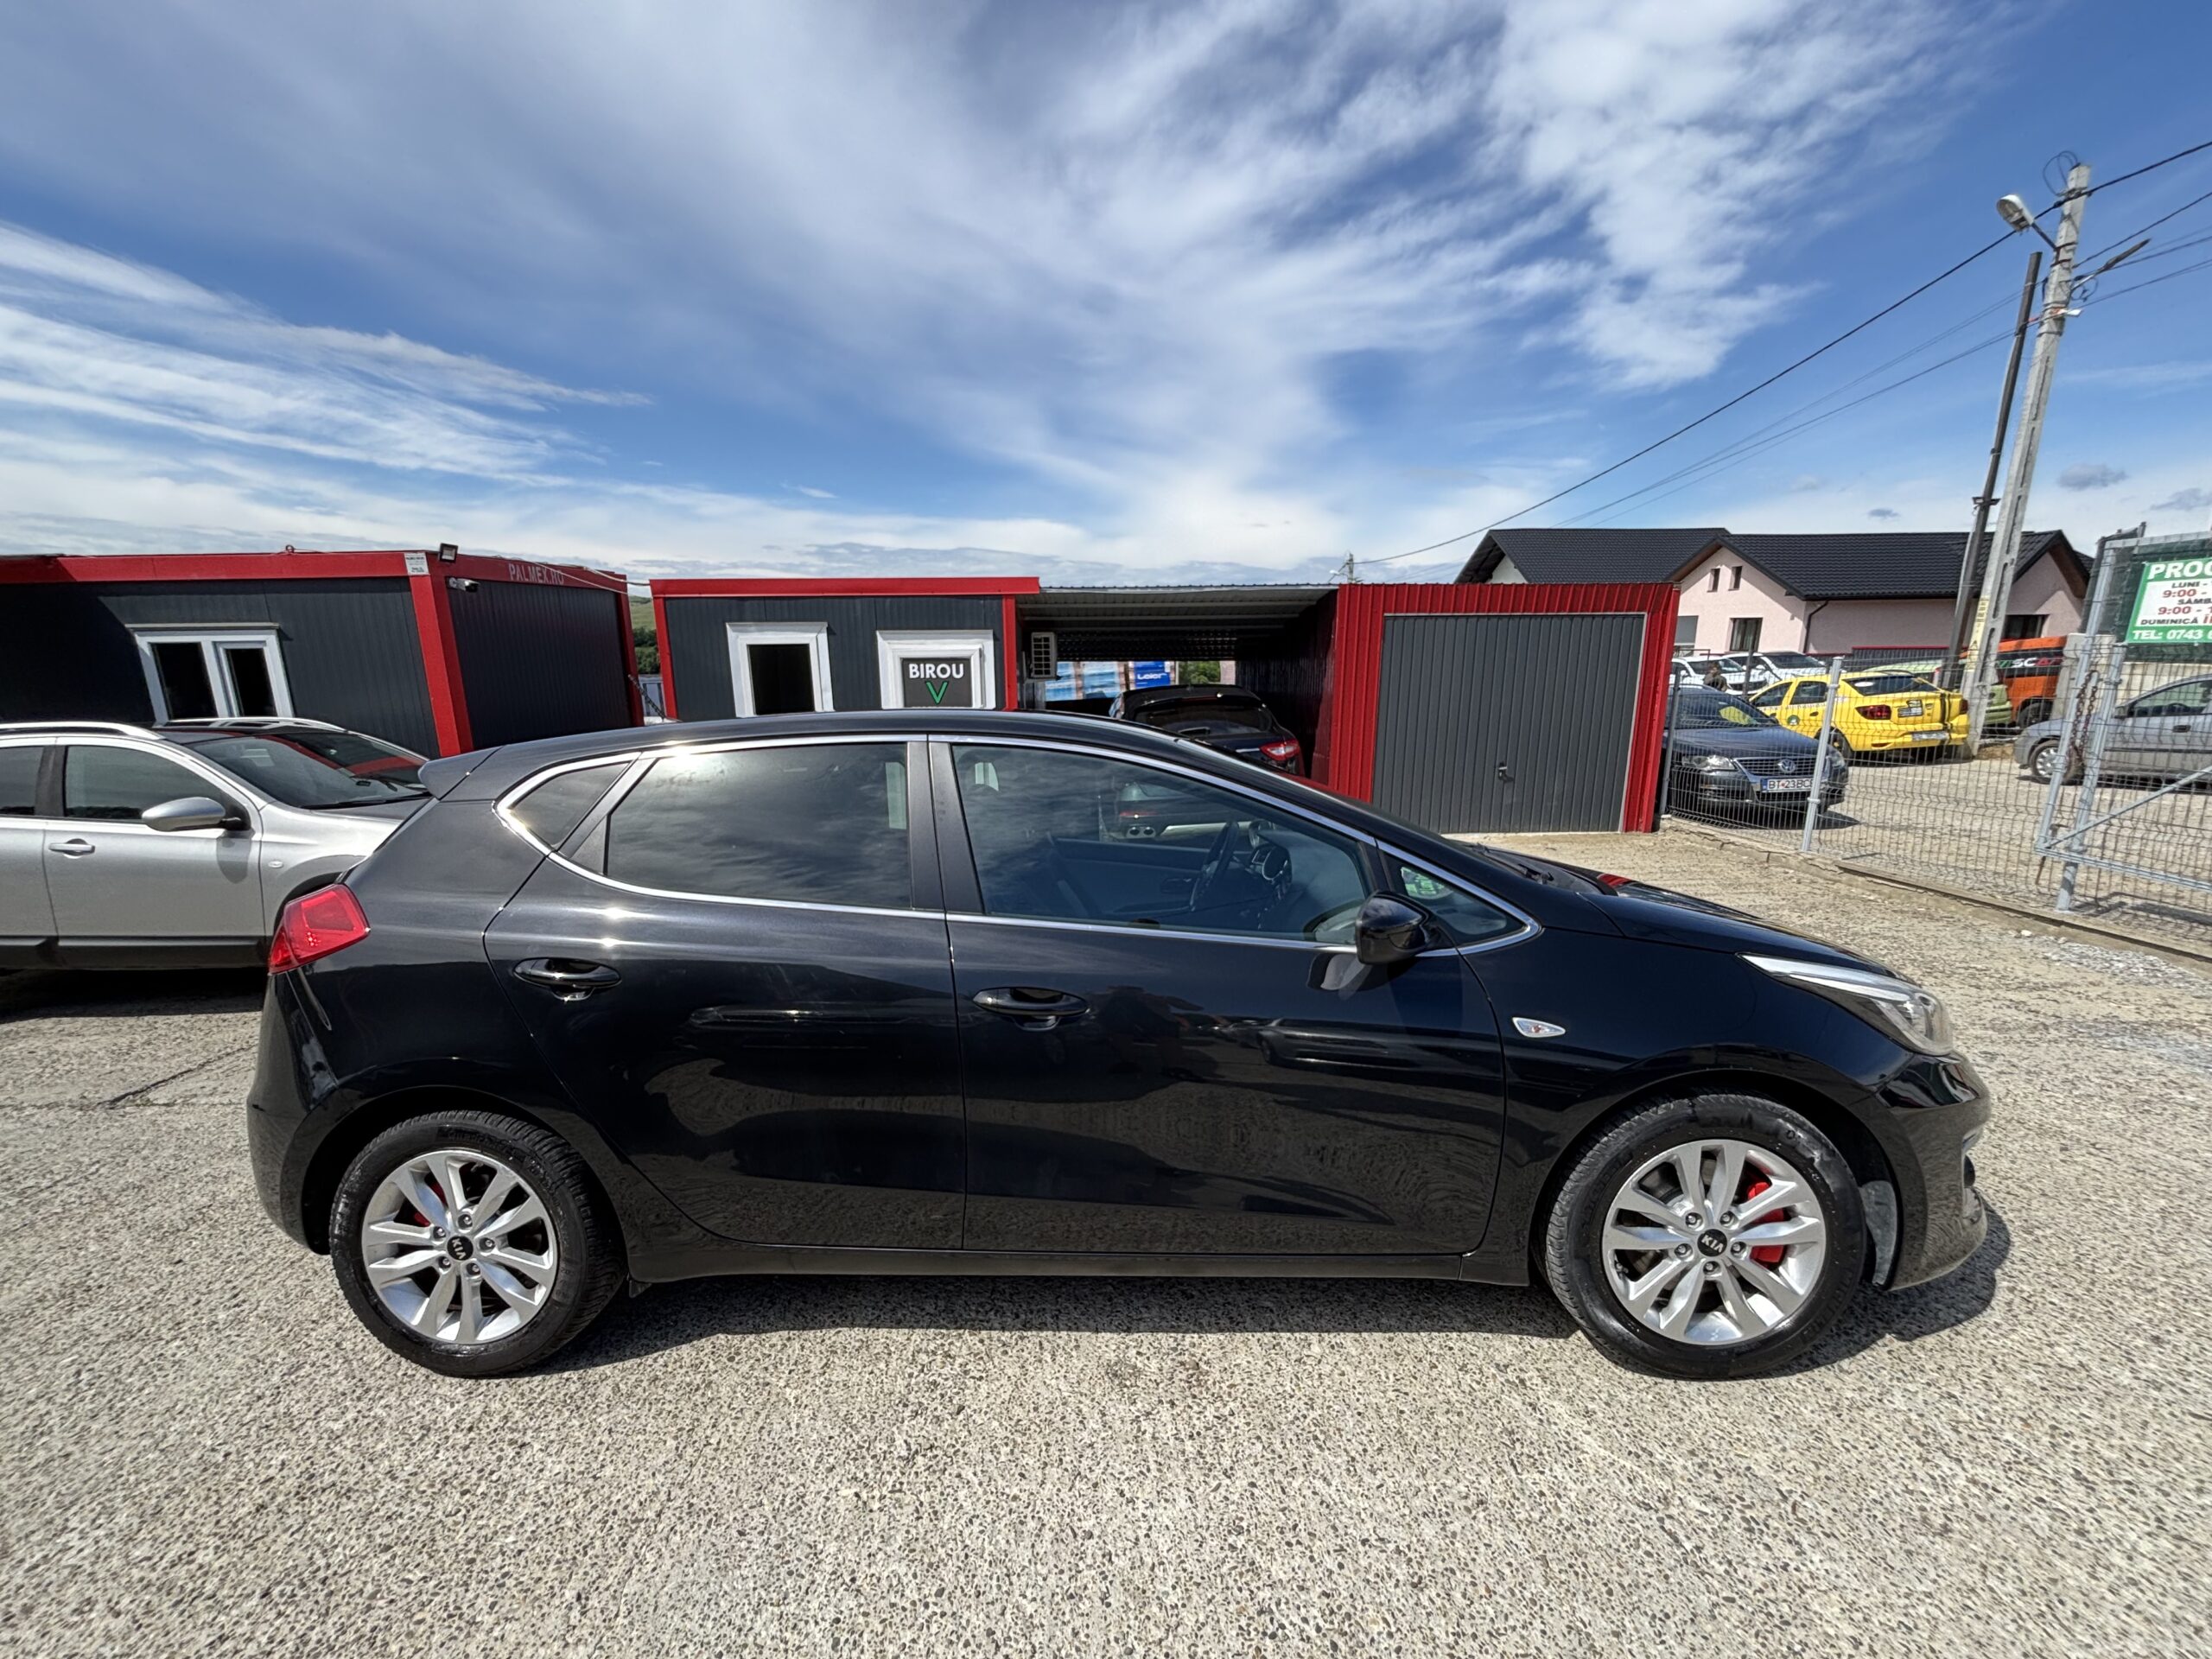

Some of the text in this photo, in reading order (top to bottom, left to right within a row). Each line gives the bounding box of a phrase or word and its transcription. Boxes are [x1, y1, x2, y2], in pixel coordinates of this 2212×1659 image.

[2163, 588, 2196, 598] 9:00
[2158, 606, 2191, 616] 9:00
[2166, 629, 2203, 639] 0743
[908, 663, 964, 678] BIROU
[452, 1238, 466, 1259] KIA
[1700, 1234, 1724, 1253] KIA
